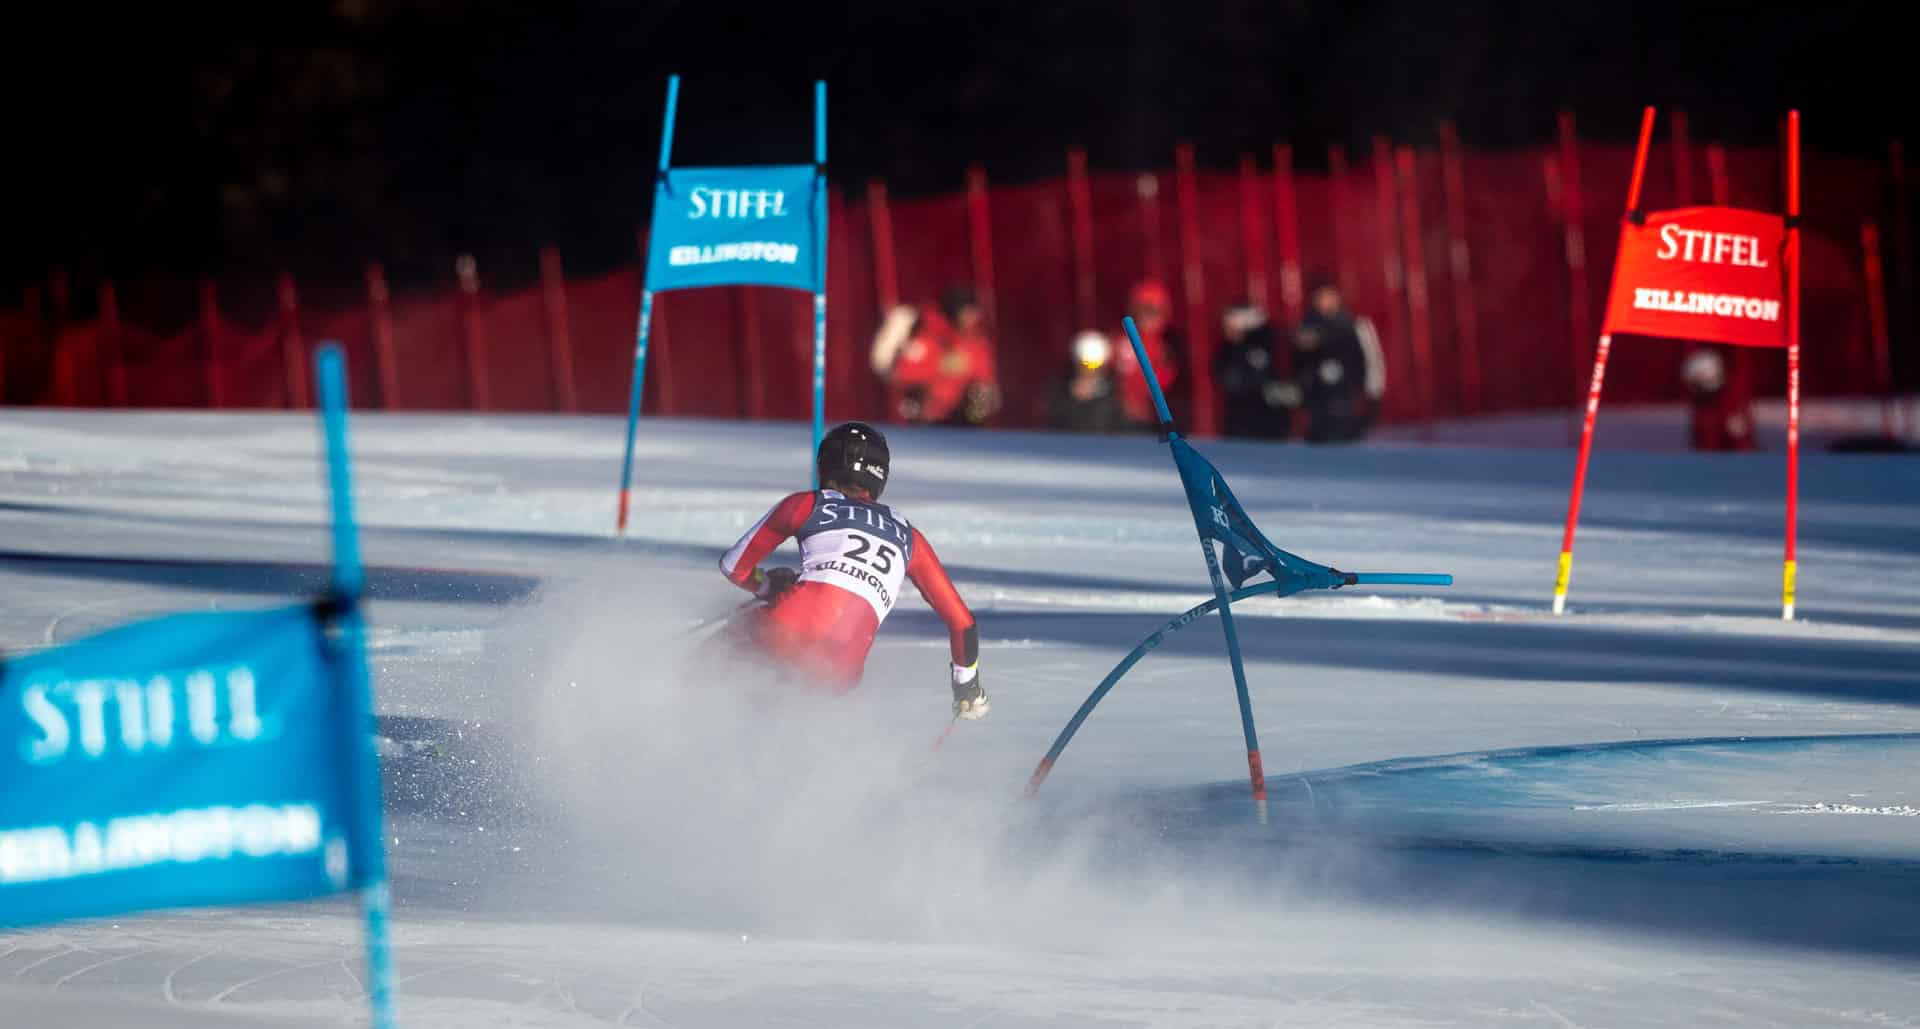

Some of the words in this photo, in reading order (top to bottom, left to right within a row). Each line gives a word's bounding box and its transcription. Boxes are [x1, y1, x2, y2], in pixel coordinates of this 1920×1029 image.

[1657, 223, 1768, 267] STIFEL
[1633, 287, 1780, 321] KILLINGTON
[843, 534, 897, 575] 25
[815, 560, 893, 609] KILLINGTON
